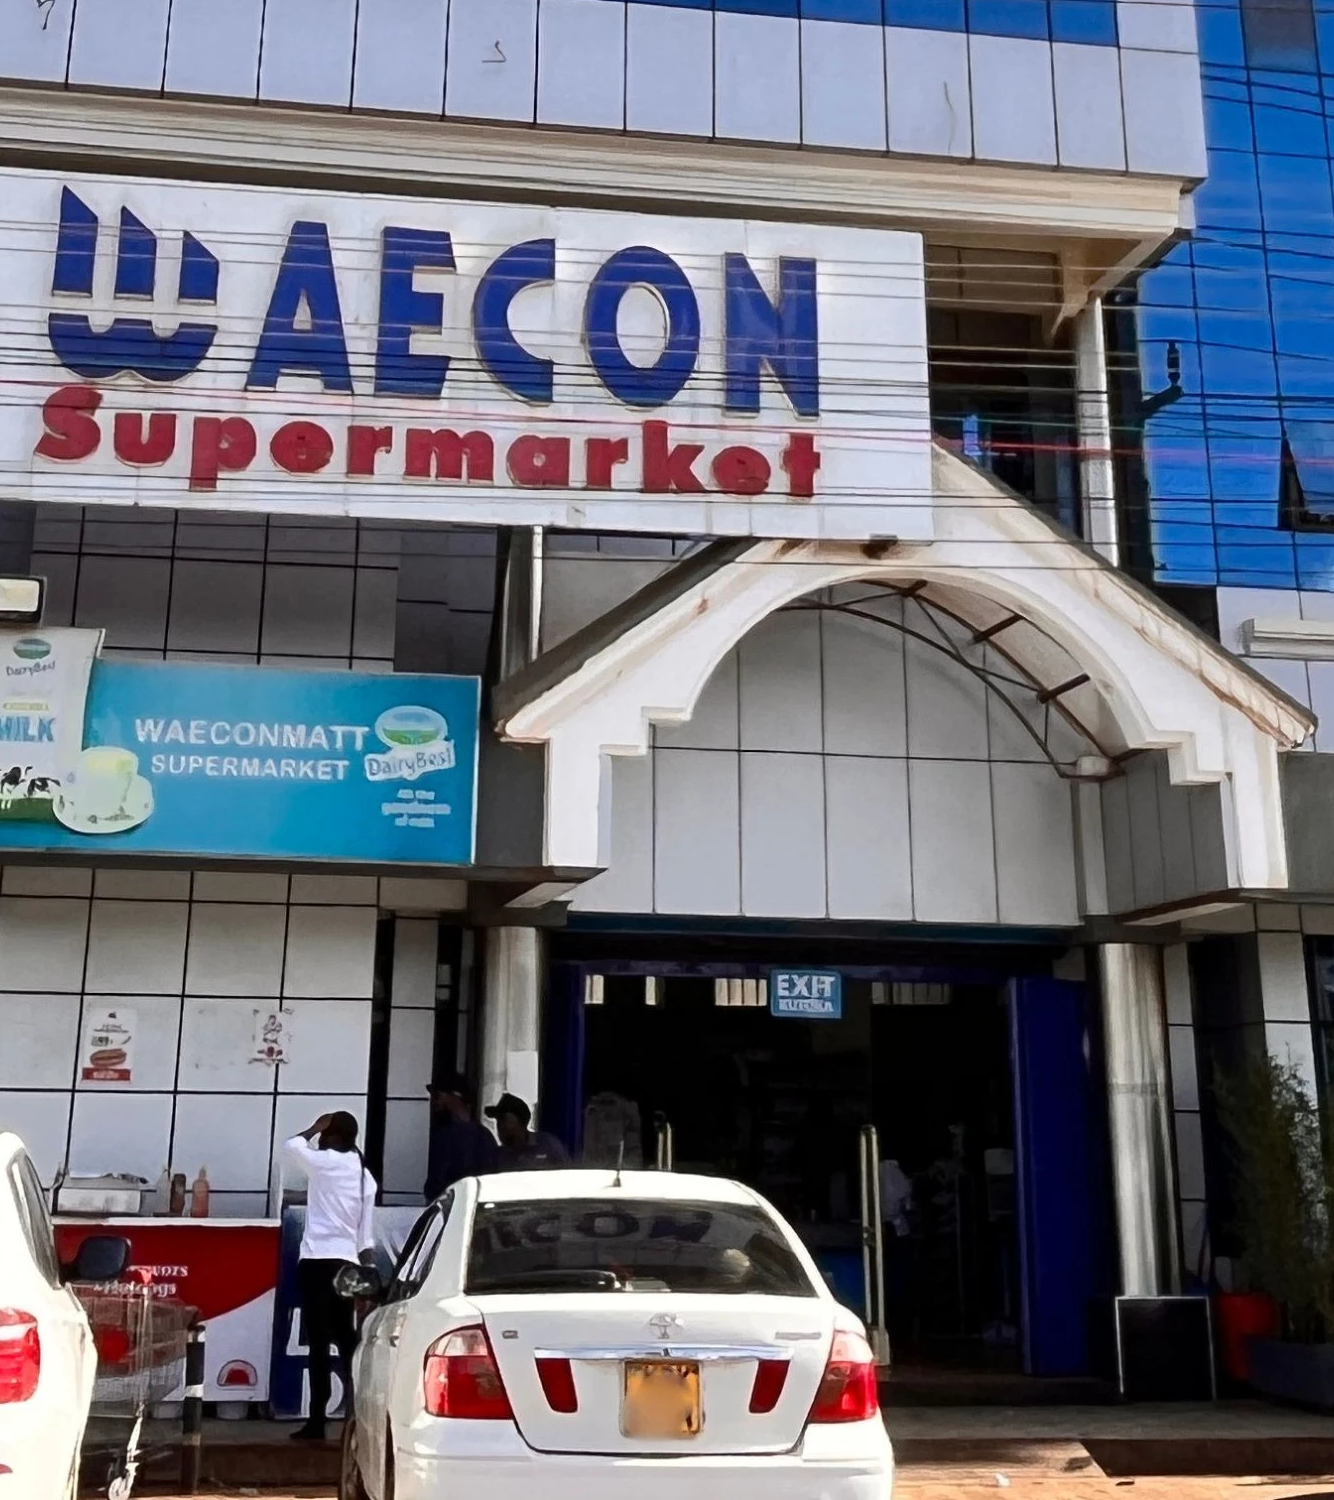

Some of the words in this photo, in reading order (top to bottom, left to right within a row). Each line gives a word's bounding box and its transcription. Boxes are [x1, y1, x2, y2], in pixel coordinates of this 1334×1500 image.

[46, 185, 822, 418] WAECON
[35, 387, 822, 498] Supermarket
[134, 717, 371, 752] WAECONMATT
[151, 754, 349, 781] SUPERMARKET
[777, 974, 835, 997] EXIT
